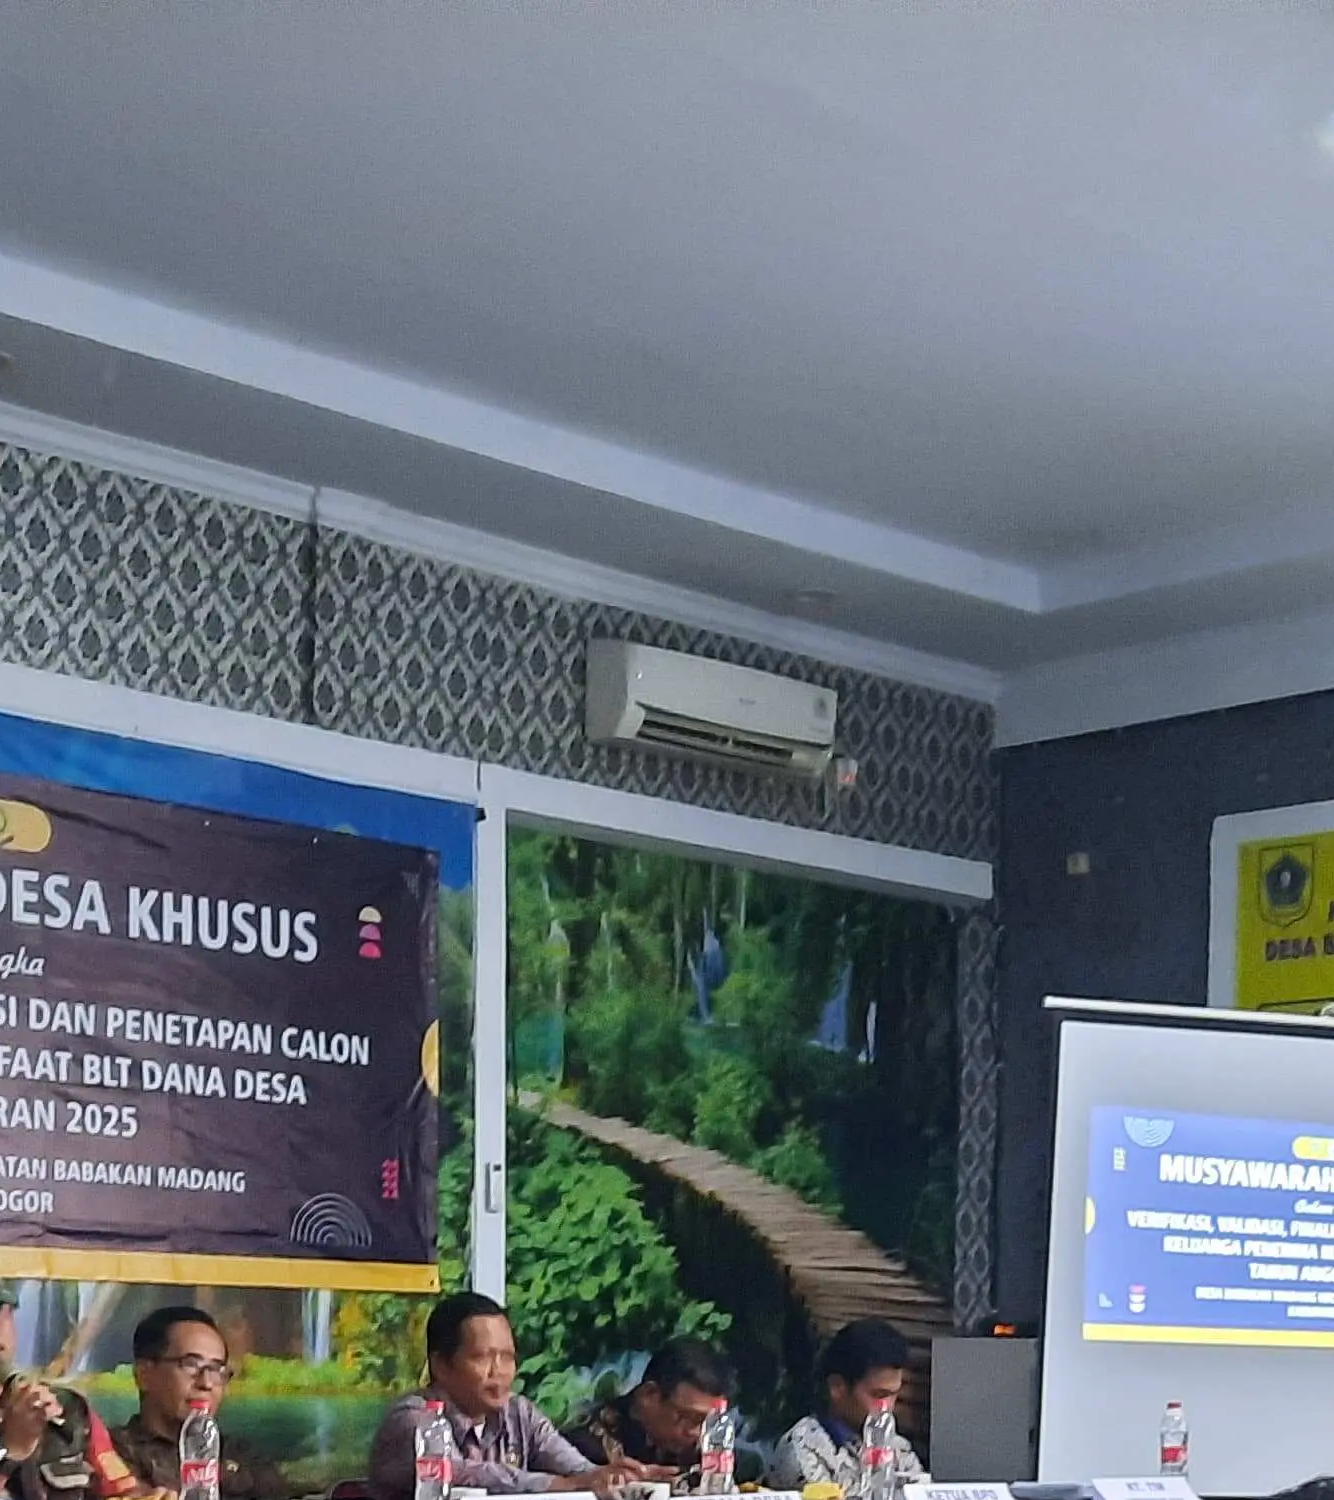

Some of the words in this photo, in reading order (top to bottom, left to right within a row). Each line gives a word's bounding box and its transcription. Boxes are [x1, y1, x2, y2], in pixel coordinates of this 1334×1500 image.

[127, 886, 320, 964] KHUSUS
[1265, 937, 1316, 961] DESA
[28, 998, 98, 1036] DAN
[106, 1007, 272, 1056] PENETAPAN
[280, 1027, 370, 1067] CALON
[81, 1053, 134, 1090] BLT
[141, 1059, 226, 1100] DANA
[233, 1068, 308, 1106] DESA
[65, 1100, 140, 1139] 2025
[53, 1157, 152, 1190] BABAKAN
[157, 1165, 247, 1194] MADANG
